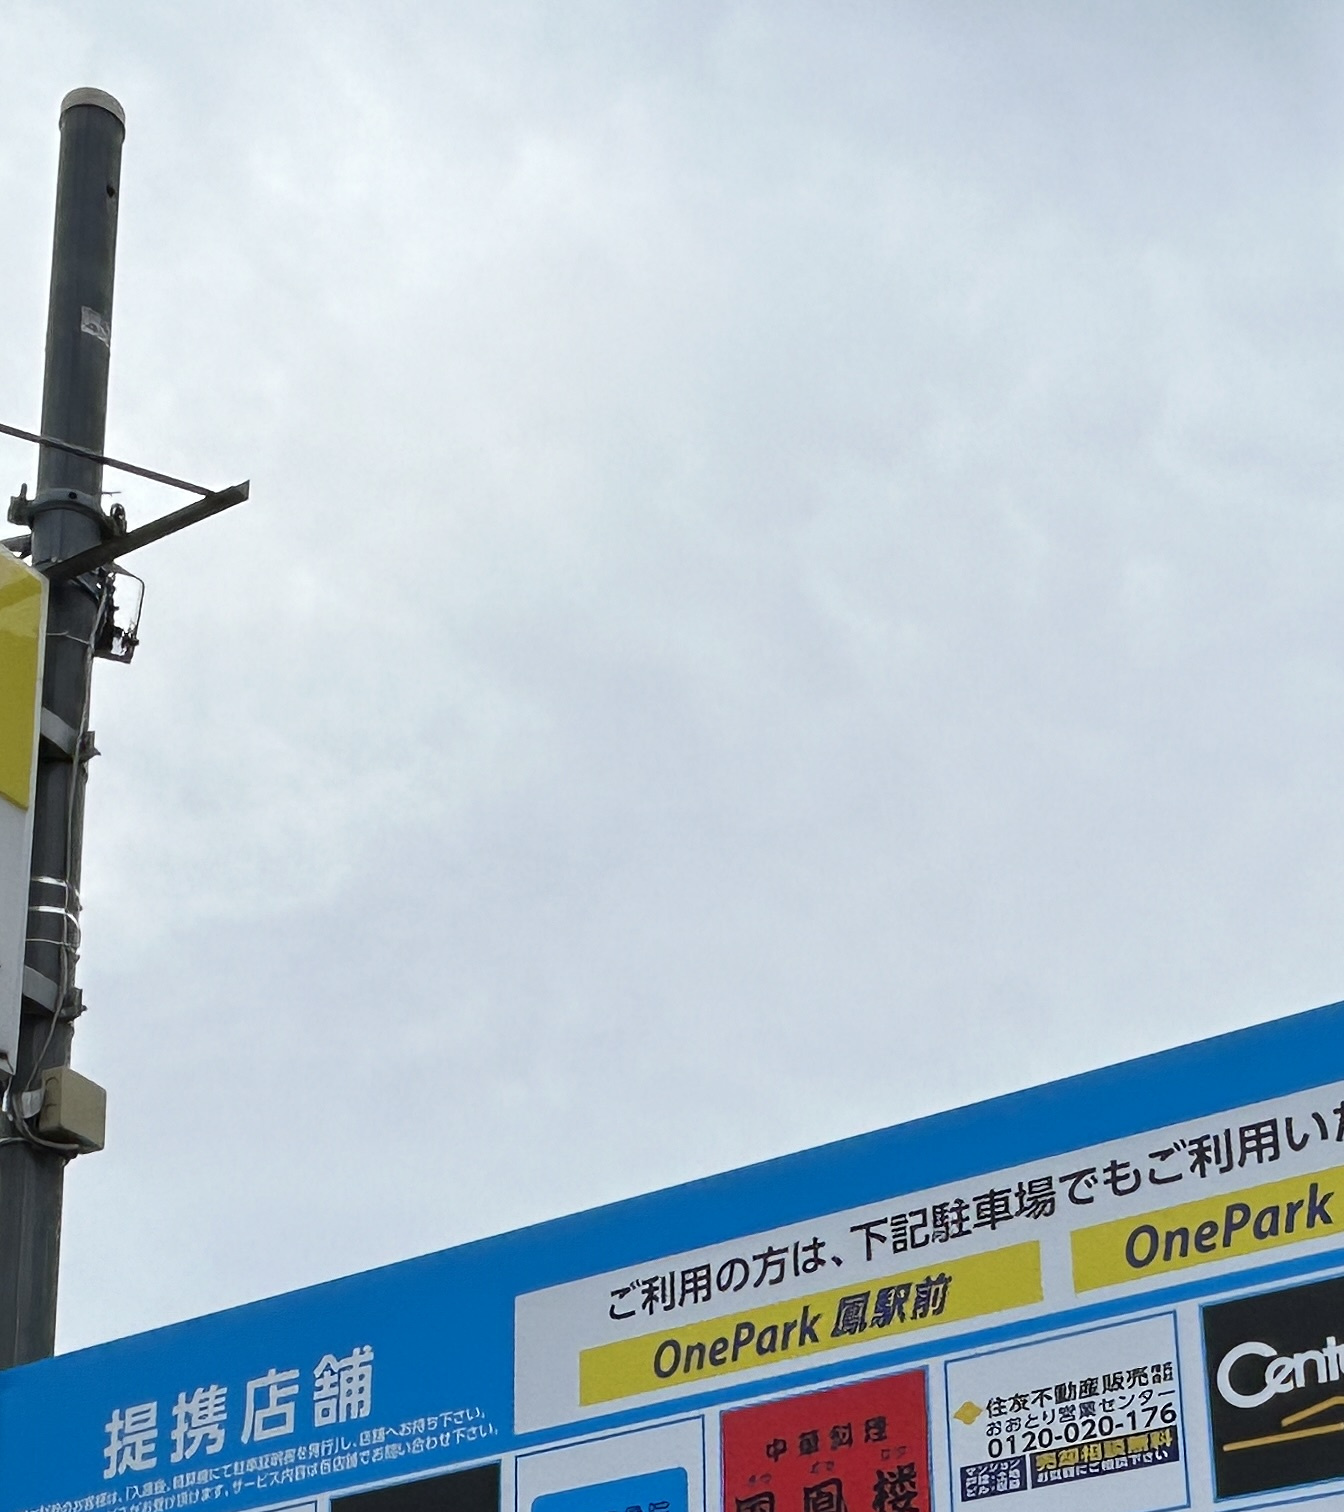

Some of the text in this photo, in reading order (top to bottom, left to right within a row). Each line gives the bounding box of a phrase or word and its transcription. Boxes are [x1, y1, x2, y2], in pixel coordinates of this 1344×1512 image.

[1126, 1182, 1334, 1268] OnePark
[654, 1272, 953, 1378] OnePark 鳳駅前
[103, 1345, 374, 1479] 提携店舗
[988, 1402, 1177, 1458] 0120-020-176
